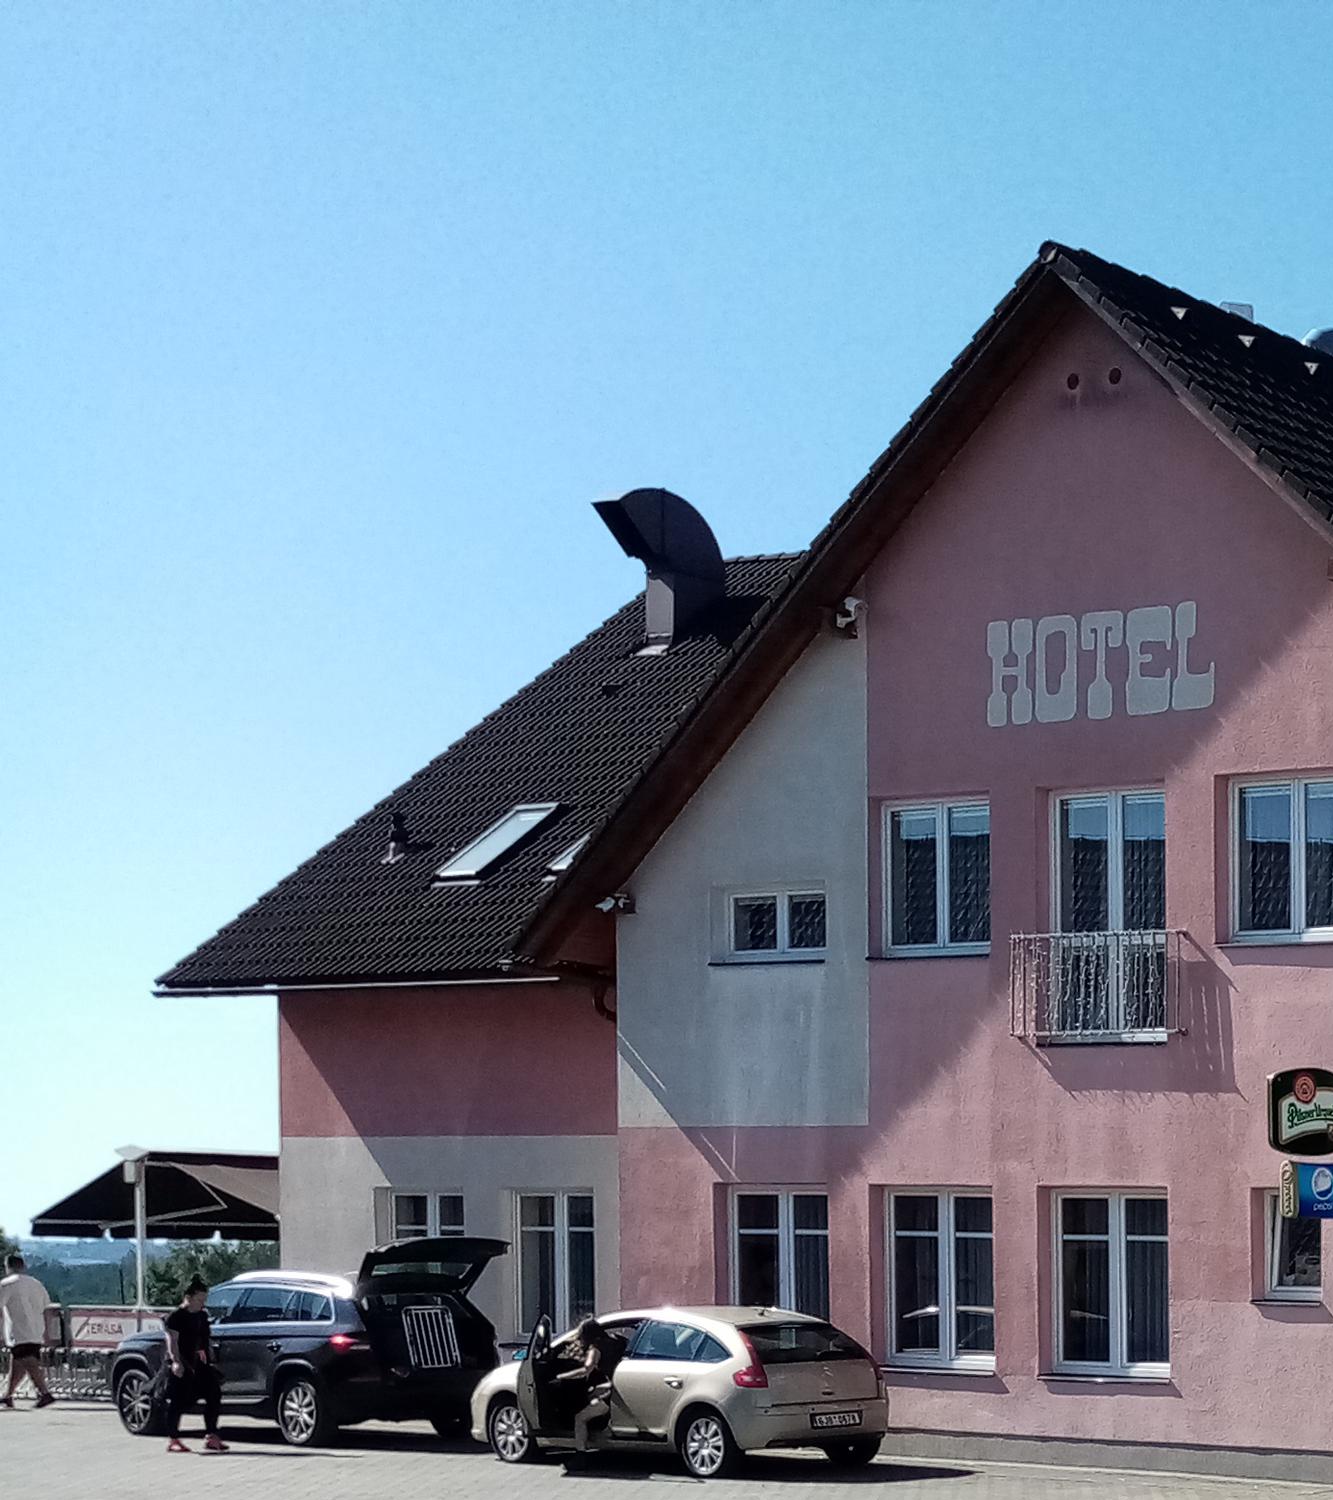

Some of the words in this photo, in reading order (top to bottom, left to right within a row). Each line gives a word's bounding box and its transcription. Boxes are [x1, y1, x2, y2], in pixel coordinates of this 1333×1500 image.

[987, 601, 1215, 727] HOTEL
[1287, 1102, 1315, 1128] Pilsner
[1313, 1202, 1333, 1211] pepsi
